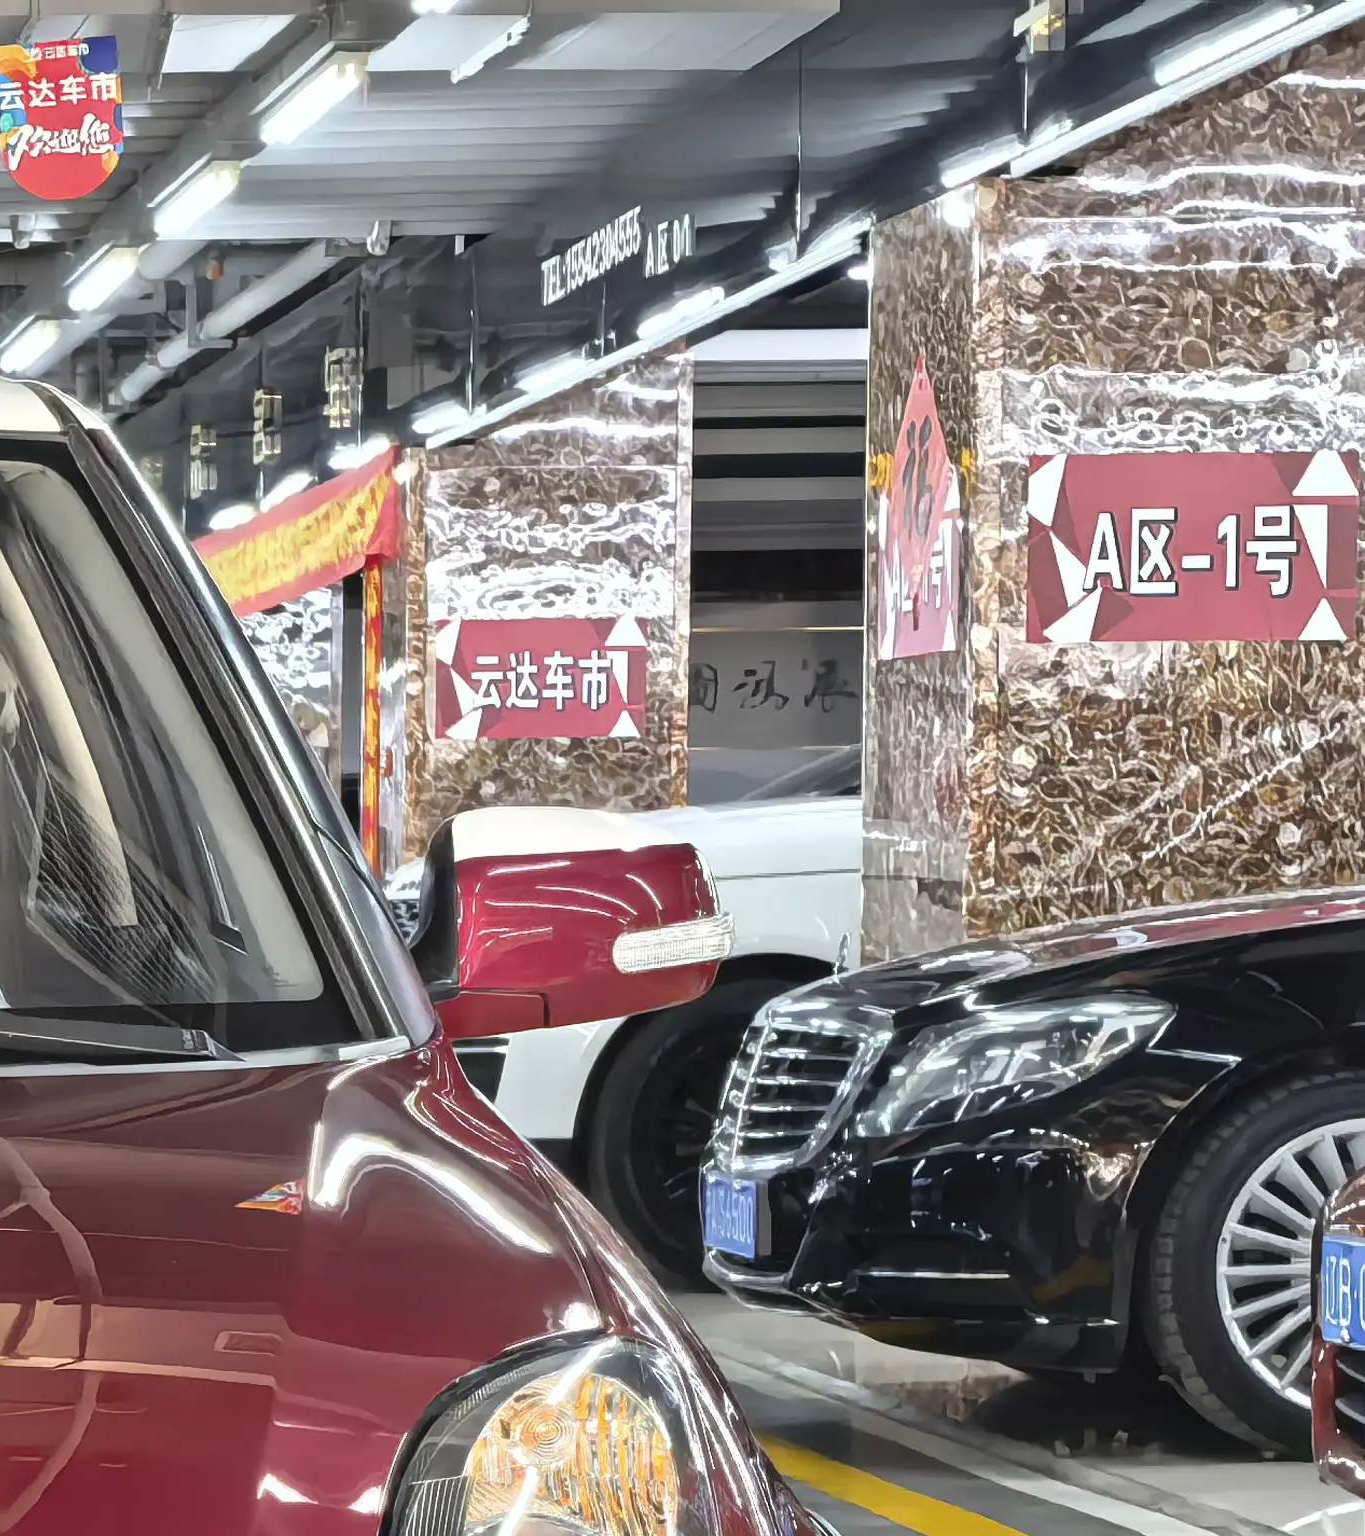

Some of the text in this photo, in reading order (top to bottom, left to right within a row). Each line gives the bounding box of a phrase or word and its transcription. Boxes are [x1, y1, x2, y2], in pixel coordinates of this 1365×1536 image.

[5, 112, 115, 171] 欢迎您
[1082, 503, 1302, 598] A区-1号
[469, 649, 609, 711] 云达车市
